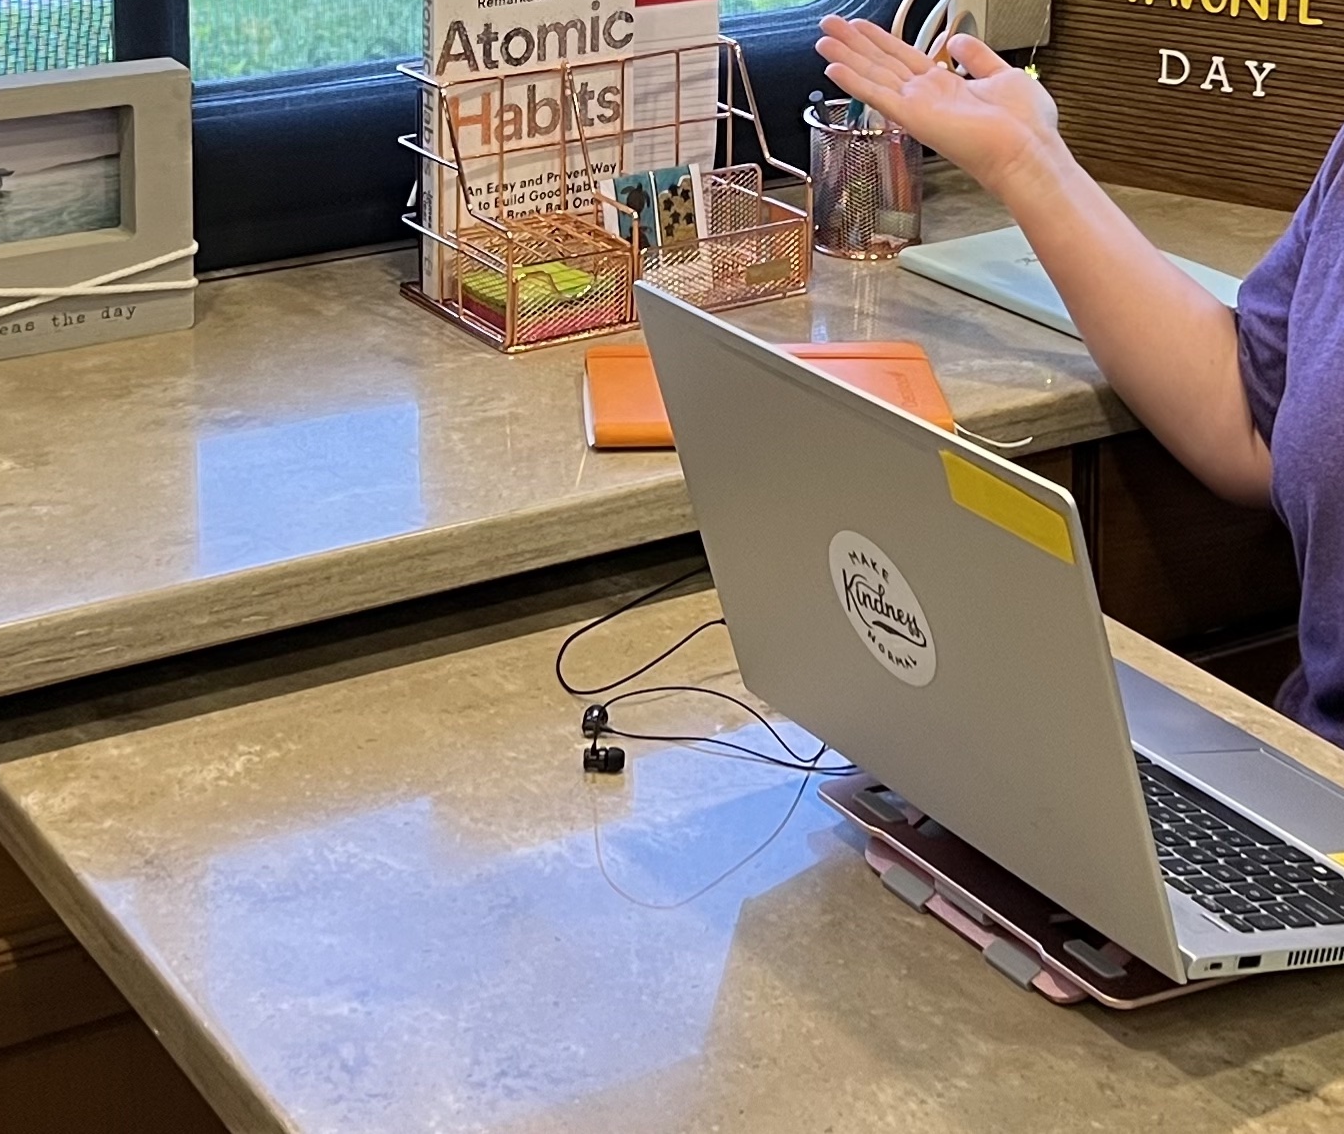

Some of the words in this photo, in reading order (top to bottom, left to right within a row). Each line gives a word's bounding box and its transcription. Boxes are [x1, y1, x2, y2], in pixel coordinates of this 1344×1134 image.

[435, 0, 635, 77] Atomic
[1157, 48, 1276, 97] DAY
[519, 173, 543, 189] and
[547, 168, 588, 183] Prven
[590, 162, 616, 174] Way
[478, 201, 490, 211] to
[51, 312, 86, 328] the
[100, 305, 137, 321] day
[847, 550, 890, 584] MAKE
[841, 568, 926, 644] Kindness
